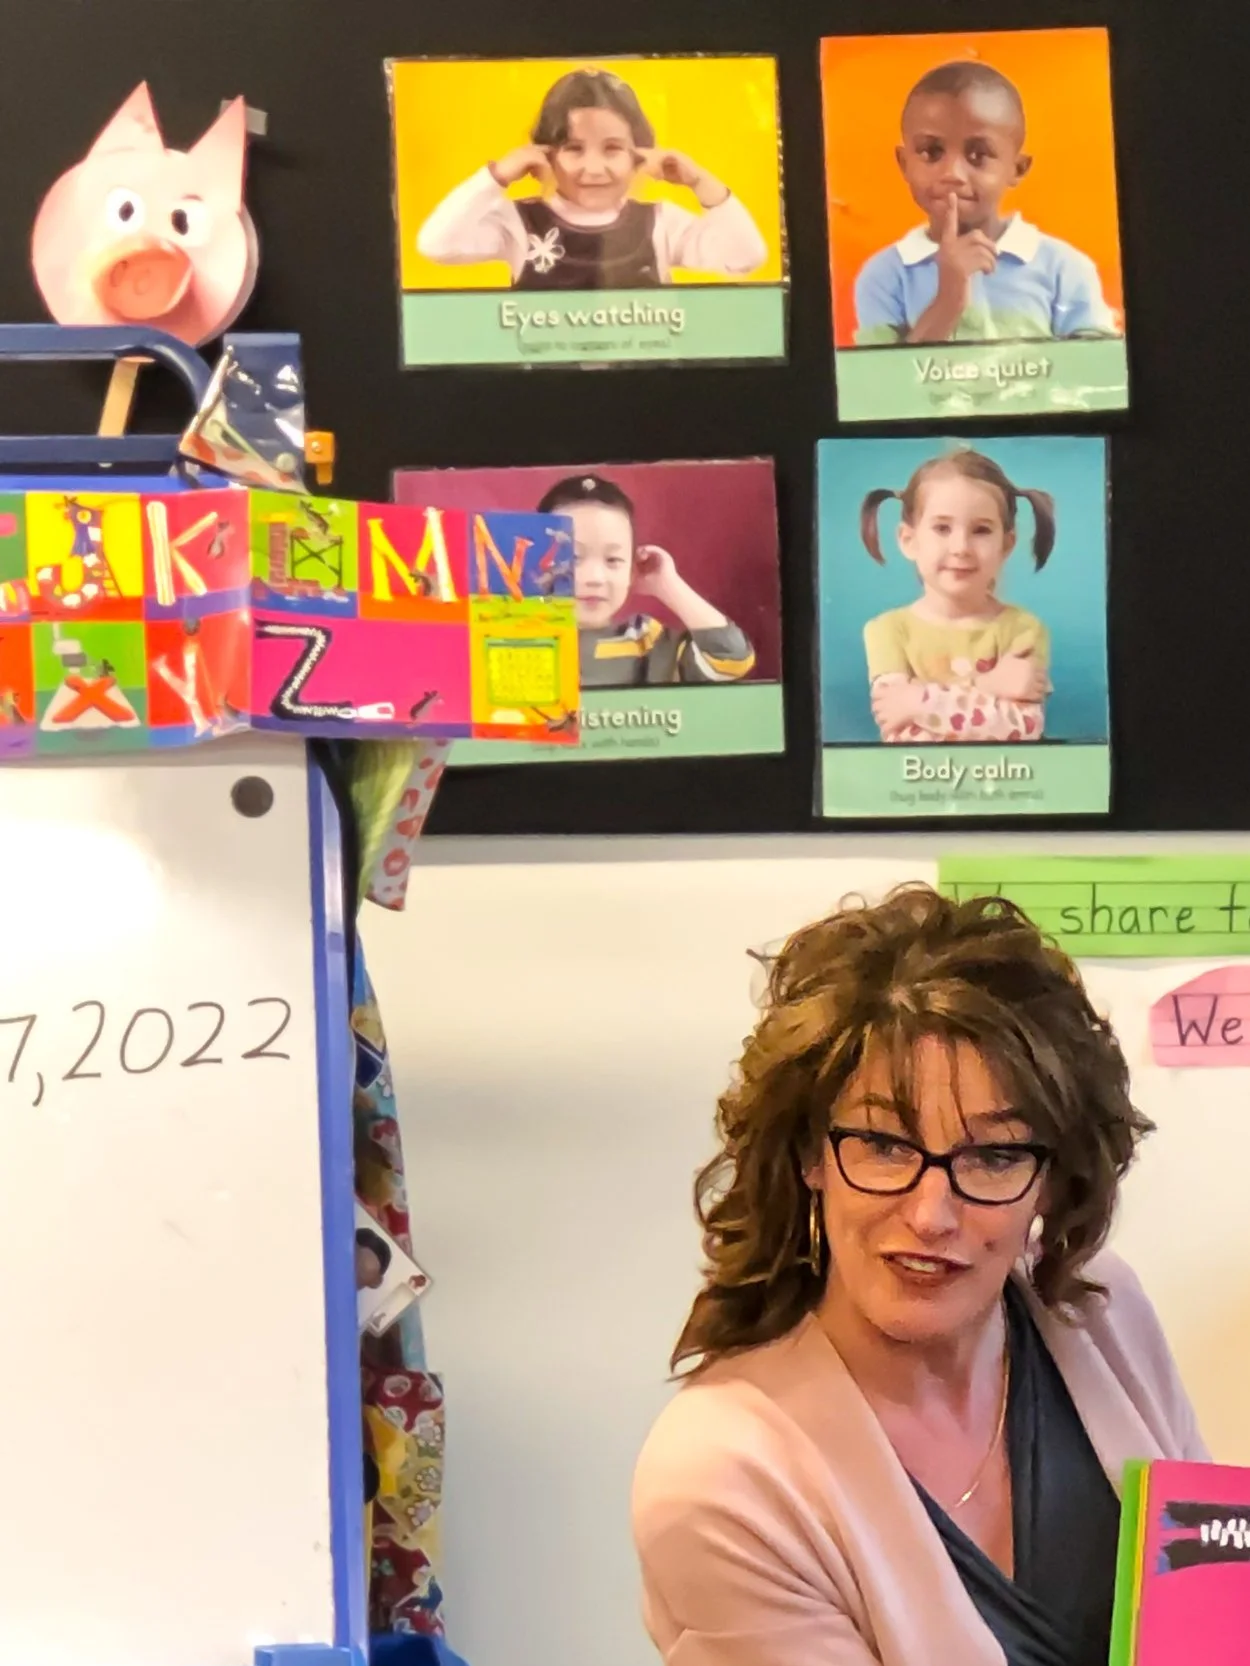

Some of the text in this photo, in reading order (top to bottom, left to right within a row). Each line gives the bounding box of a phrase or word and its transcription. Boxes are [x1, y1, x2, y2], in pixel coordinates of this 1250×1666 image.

[501, 301, 685, 334] Eyes watching
[912, 355, 1052, 387] Voice quiet
[146, 500, 218, 606] K
[367, 507, 460, 603] M
[473, 514, 534, 604] N
[255, 618, 362, 722] Z
[51, 674, 137, 724] X
[580, 706, 682, 735] istening
[903, 754, 1032, 790] Body calm
[1059, 882, 1197, 935] share
[1172, 993, 1245, 1047] We
